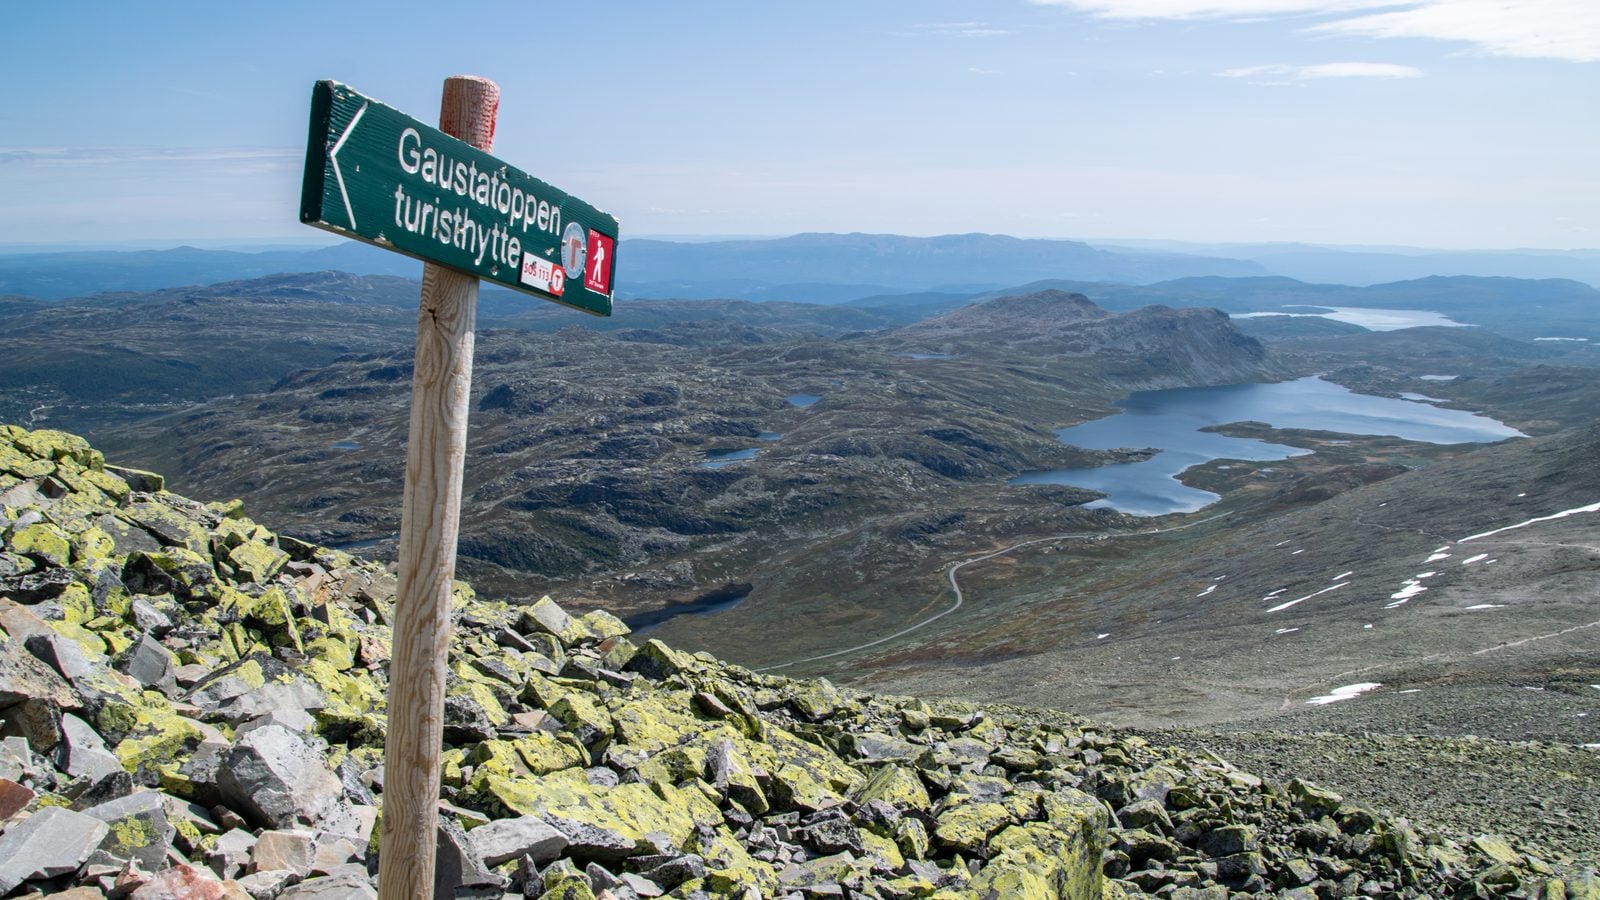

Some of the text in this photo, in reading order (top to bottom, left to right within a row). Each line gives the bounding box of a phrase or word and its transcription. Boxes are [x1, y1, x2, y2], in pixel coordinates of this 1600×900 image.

[398, 127, 561, 236] Gaustatoppen
[394, 183, 521, 269] turisthytte
[524, 262, 550, 282] SOS 113
[555, 274, 561, 288] T
